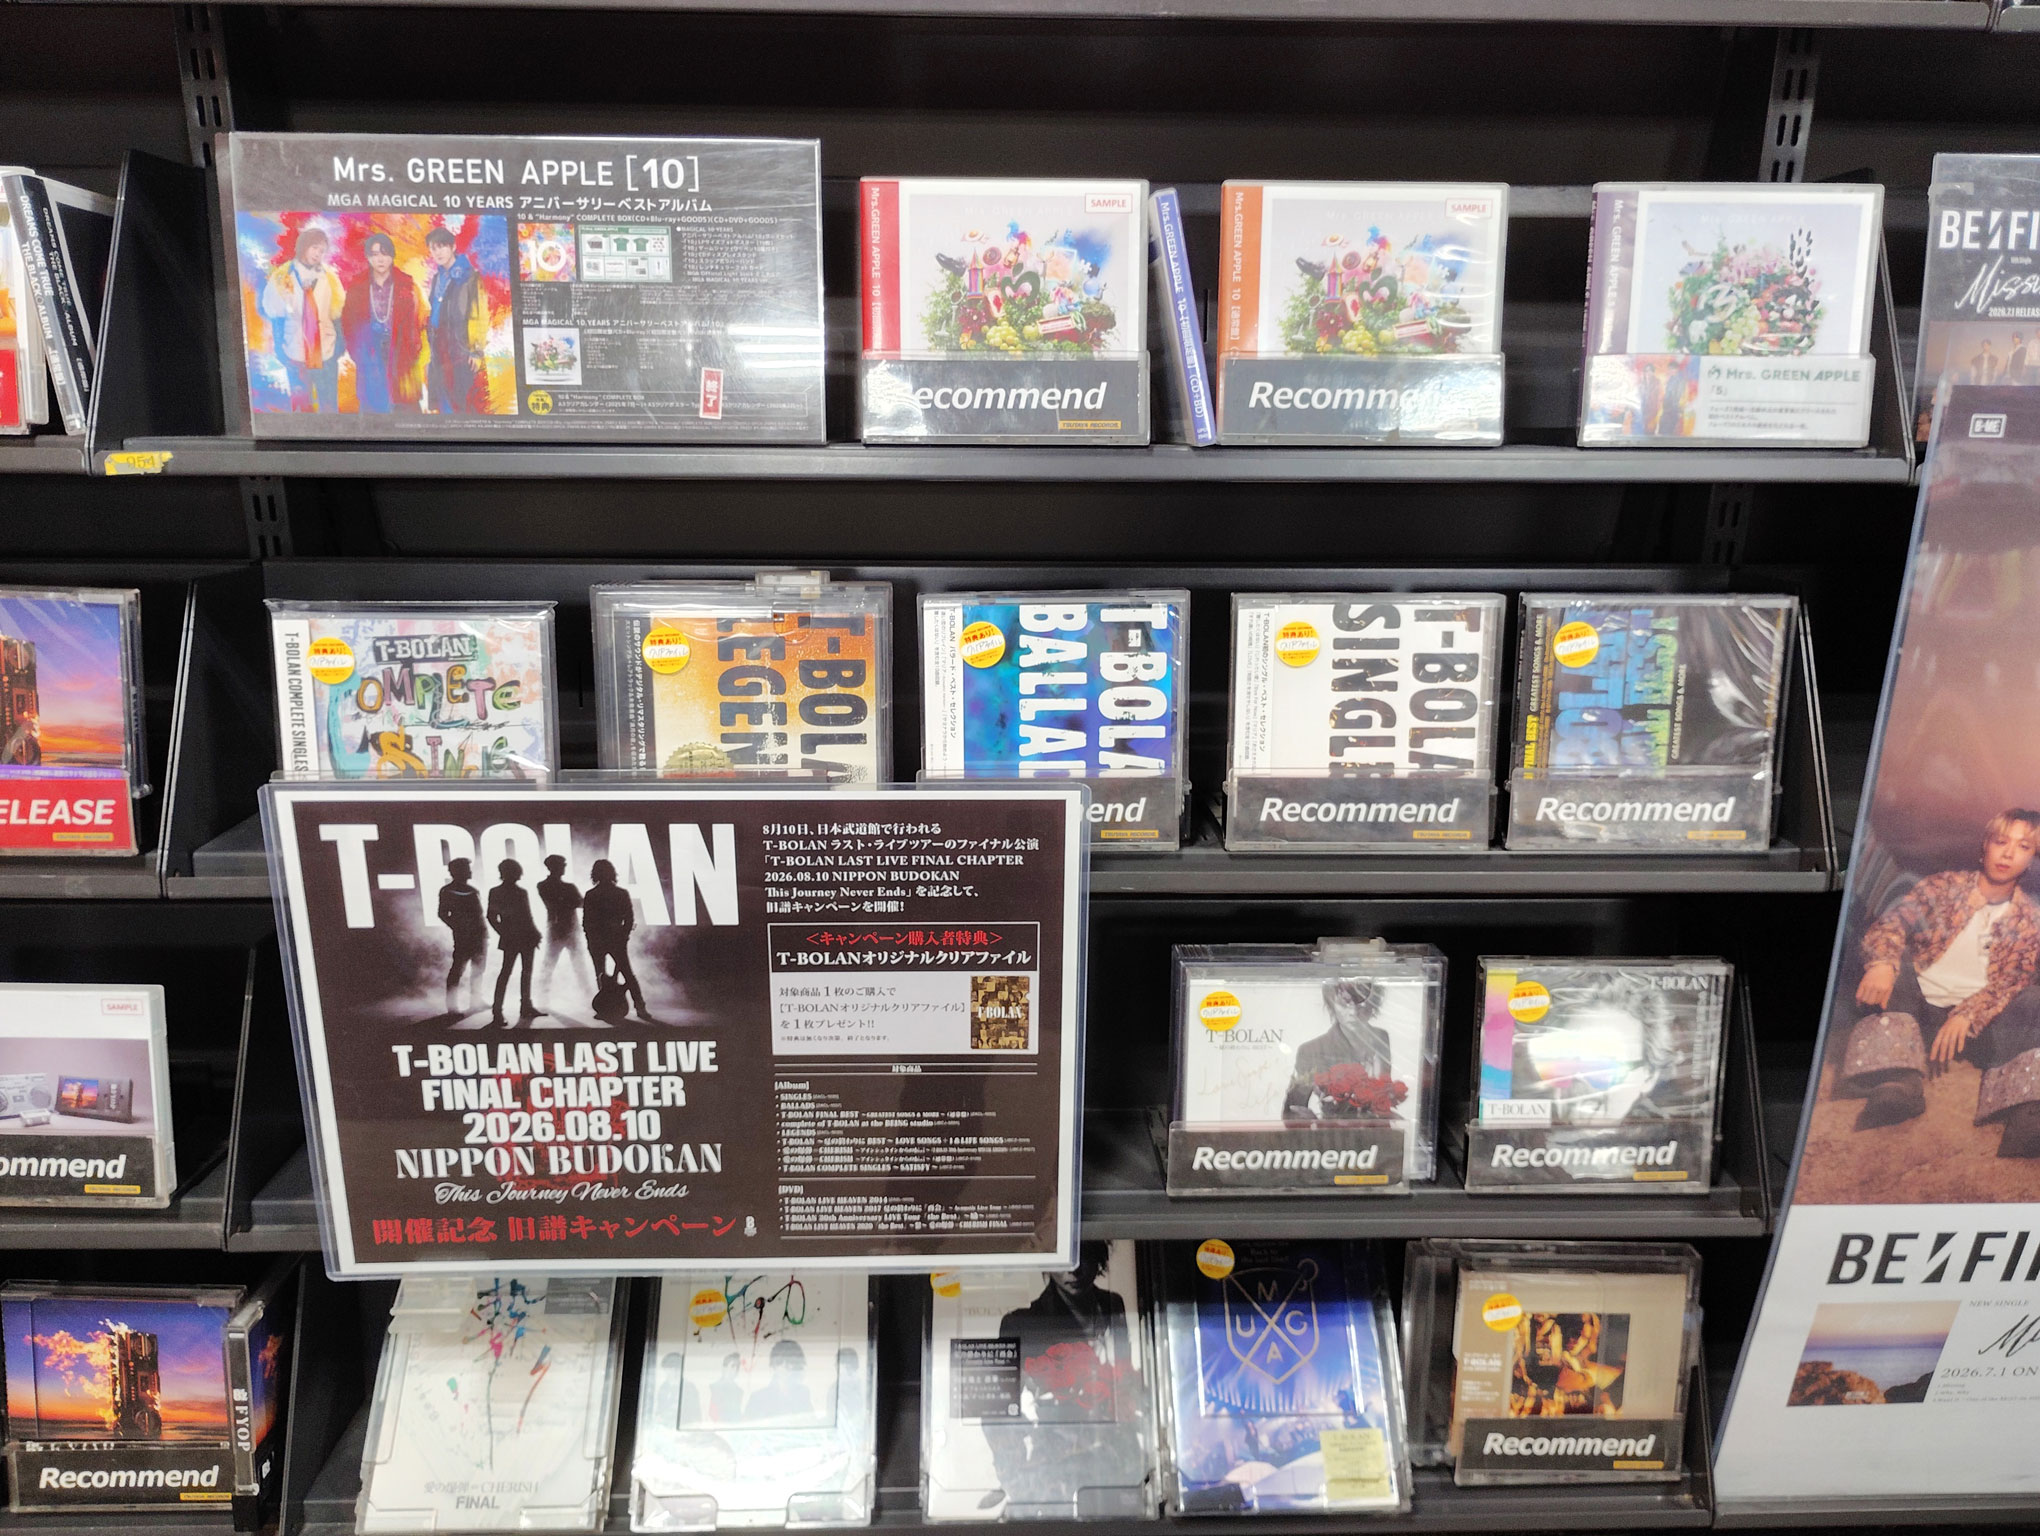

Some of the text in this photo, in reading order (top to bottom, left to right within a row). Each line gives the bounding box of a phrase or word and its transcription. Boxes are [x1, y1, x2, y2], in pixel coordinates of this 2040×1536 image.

[333, 155, 699, 192] Mrs. GREEN APPLE [10]
[328, 194, 713, 212] MGA MAGICAL 10 YEARS アニバーサリーベストアルバム
[1090, 198, 1127, 209] SAMPLE
[1451, 203, 1487, 214] SAMPLE
[576, 214, 615, 222] COMPLETE
[1939, 210, 2040, 250] BE:FI
[20, 195, 54, 297] DREAMS COME TRUE
[21, 242, 32, 260] THE
[1610, 226, 1622, 262] GREEN
[871, 246, 881, 278] APPLE
[1232, 250, 1242, 283] APPLE
[1172, 261, 1184, 294] APPLE
[1607, 265, 1619, 298] APPLE
[872, 284, 881, 297] 10
[1231, 288, 1241, 300] 10
[2016, 306, 2040, 317] RELEAS
[1726, 368, 1860, 382] Mrs. GREEN APPLE
[706, 380, 718, 408] 終了
[912, 382, 1107, 410] ecommend
[1249, 381, 1437, 410] Recomm
[964, 628, 995, 645] 特典あり!
[1535, 614, 1544, 637] MORE
[375, 635, 473, 662] T-BOLAN
[650, 637, 682, 646] 特典あり!
[1532, 646, 1542, 674] SONGS
[1677, 665, 1687, 686] MORE
[284, 632, 309, 773] T-BOLAN COMPLETE SINGLES
[717, 616, 789, 767] LEGEN
[798, 615, 868, 783] T-BOLA
[1098, 603, 1167, 778] T-BOLA
[1329, 604, 1401, 778] SINGLE
[1409, 607, 1481, 778] T-BOLA
[1529, 674, 1541, 712] GREATEST
[1674, 696, 1684, 722] SONGS
[1526, 715, 1539, 742] BEST
[1671, 723, 1682, 759] GREATEST
[1260, 798, 1461, 824] Recommend
[1535, 797, 1736, 823] Recommend
[762, 823, 942, 836] 8月10日、日本武道館で行われる
[762, 838, 1040, 851] T-BOLAN ラスト・ライブツアーのファイナル公演
[764, 855, 1024, 866] 「T-BOLAN LAST LIVE FINAL CHAPTER
[318, 823, 739, 929] T-BOLAN
[764, 870, 960, 882] 2026.08.10 NIPPON BUDOKAN
[765, 886, 979, 900] This Journey Never Ends」 を記念して、
[766, 901, 905, 913] 旧譜キャンペーンを開催!
[805, 931, 1003, 946] ＜キャンペーン購入者特典＞
[776, 950, 1031, 966] T-BOLANオリジナルクリアファイル
[1648, 975, 1709, 991] T-BOLAN
[107, 1003, 138, 1012] SAMPLE
[779, 1002, 966, 1015] 【T-BOLANオリジナルクリアファイル】
[977, 1005, 1022, 1019] T-BOLAN
[1206, 1028, 1284, 1043] T-BOLAN
[392, 1040, 718, 1077] T-BOLAN LAST LIVE
[421, 1075, 686, 1111] FINAL CHAPTER
[780, 1093, 812, 1101] SINGLES
[780, 1102, 815, 1110] BALLADS
[1487, 1102, 1547, 1116] T-BOLAN
[462, 1109, 661, 1144] 2026.08.10
[781, 1120, 815, 1129] complete
[817, 1119, 825, 1127] of
[827, 1119, 859, 1127] T-BOLAN
[870, 1119, 883, 1127] the
[885, 1119, 908, 1127] BEING
[910, 1119, 934, 1127] studio
[781, 1129, 816, 1137] LEGENDS
[0, 1153, 127, 1179] ommend
[394, 1143, 722, 1179] NIPPON BUDOKAN
[1192, 1144, 1379, 1170] Recommend
[1491, 1141, 1678, 1168] Recommend
[435, 1180, 689, 1205] This Journey Never Ends
[372, 1213, 737, 1244] 開催記念 旧譜キャンペーン
[1826, 1230, 2040, 1285] BE:FI
[1969, 1299, 2029, 1307] NEW SINGLE
[1940, 1365, 2040, 1379] 2026.7.1 ON
[234, 1405, 252, 1452] FYOP
[1483, 1432, 1656, 1457] Recommend
[38, 1465, 220, 1489] Recommend
[456, 1495, 501, 1509] FINAL
